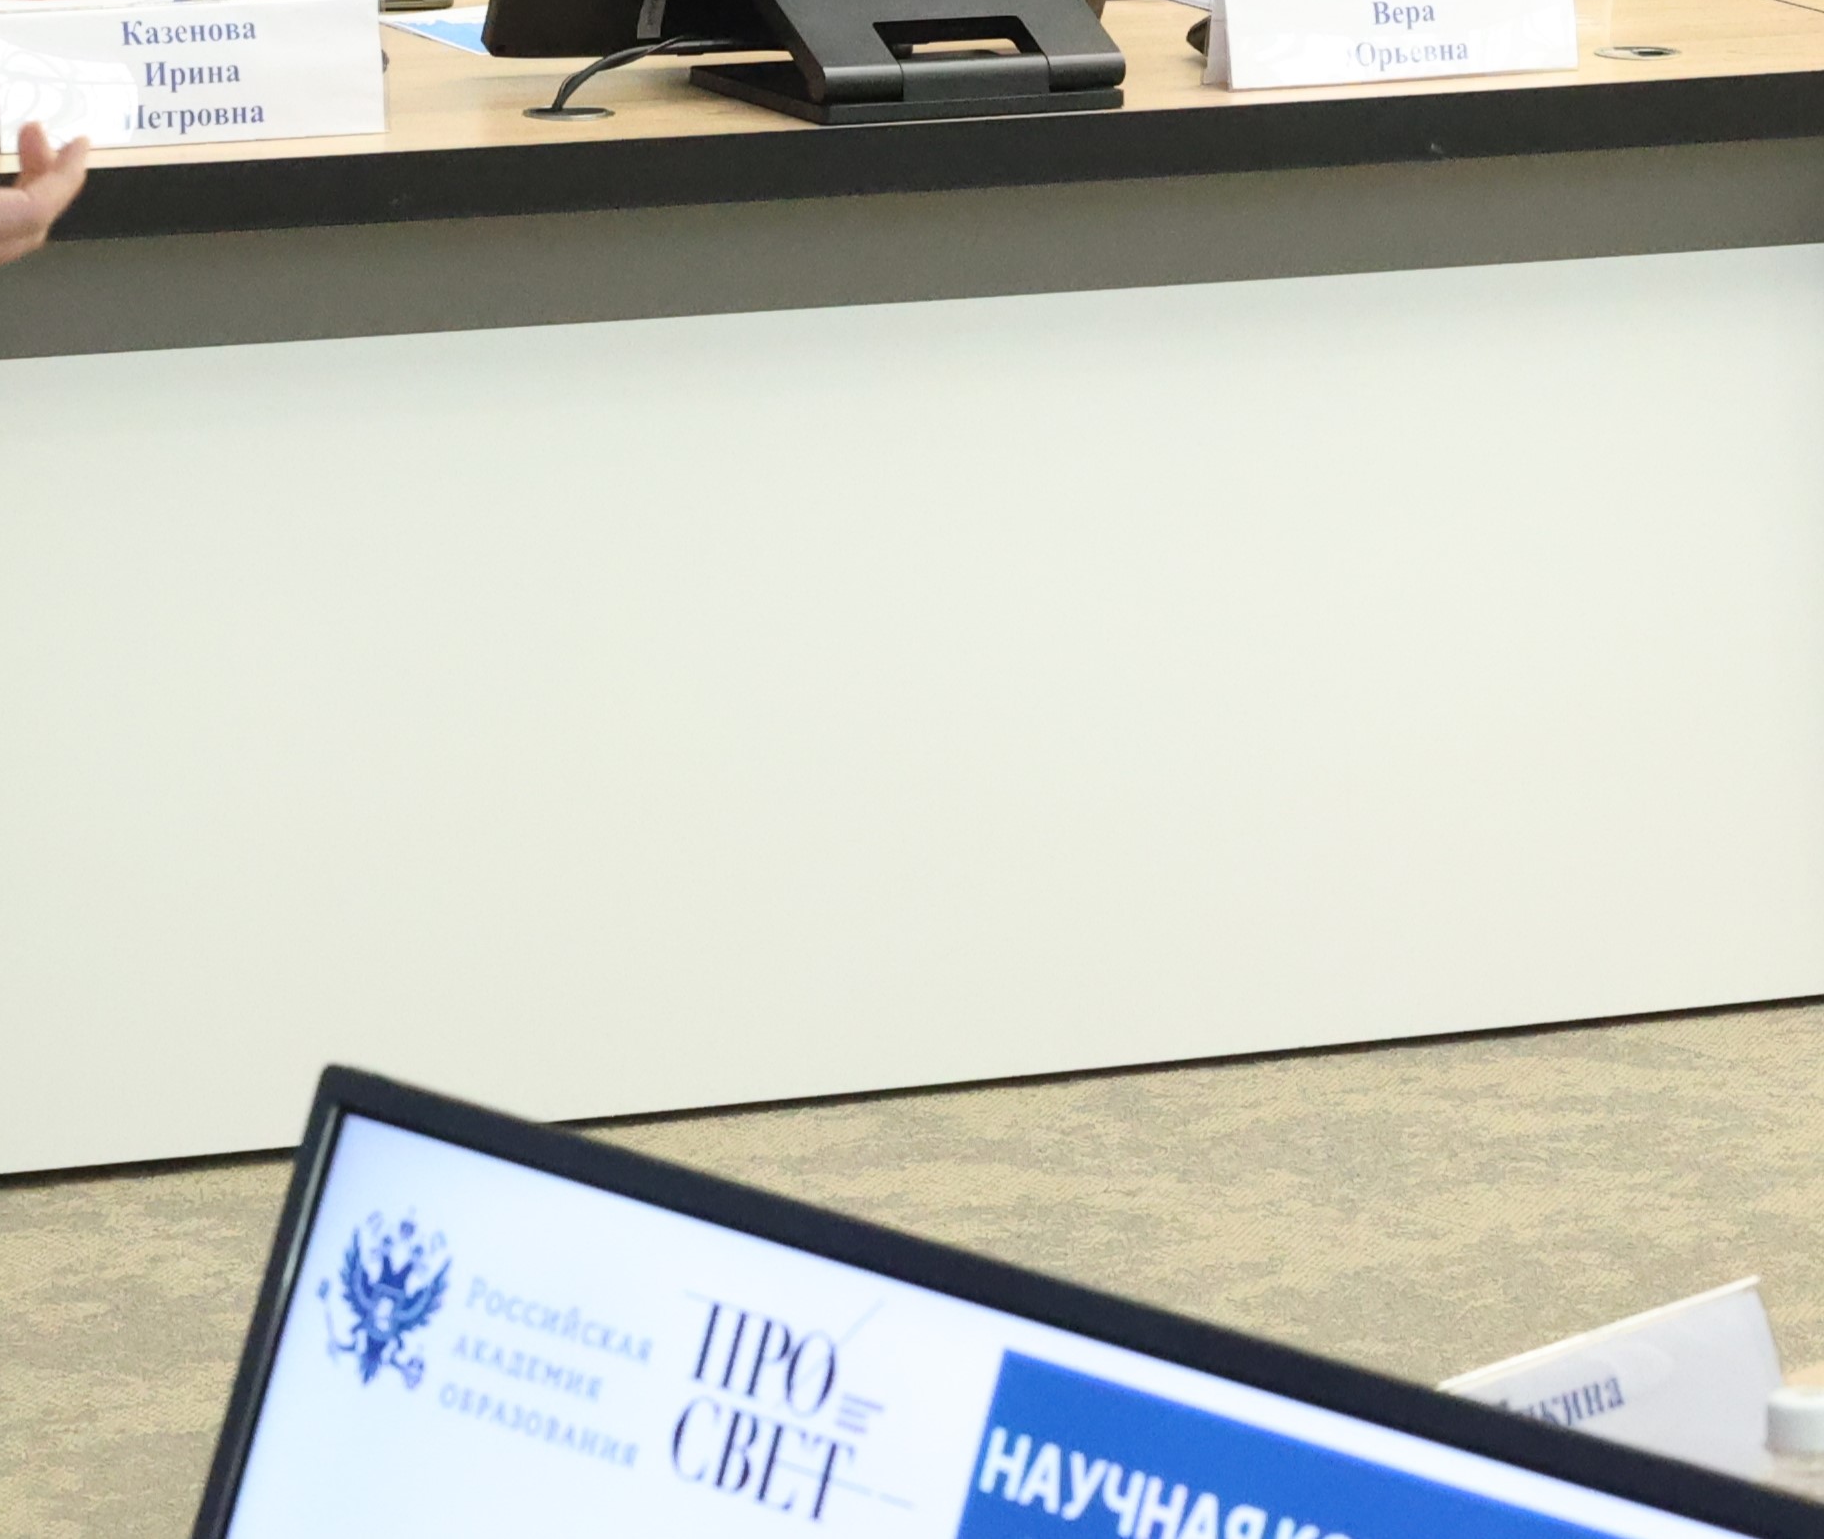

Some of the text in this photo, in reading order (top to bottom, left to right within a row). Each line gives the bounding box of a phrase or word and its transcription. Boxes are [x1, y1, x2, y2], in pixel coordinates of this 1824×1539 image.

[1372, 1, 1435, 29] Вера
[121, 20, 256, 46] Казенова
[145, 61, 240, 93] Ирина
[693, 1302, 837, 1418] ПРО
[672, 1395, 857, 1522] СВЕТ
